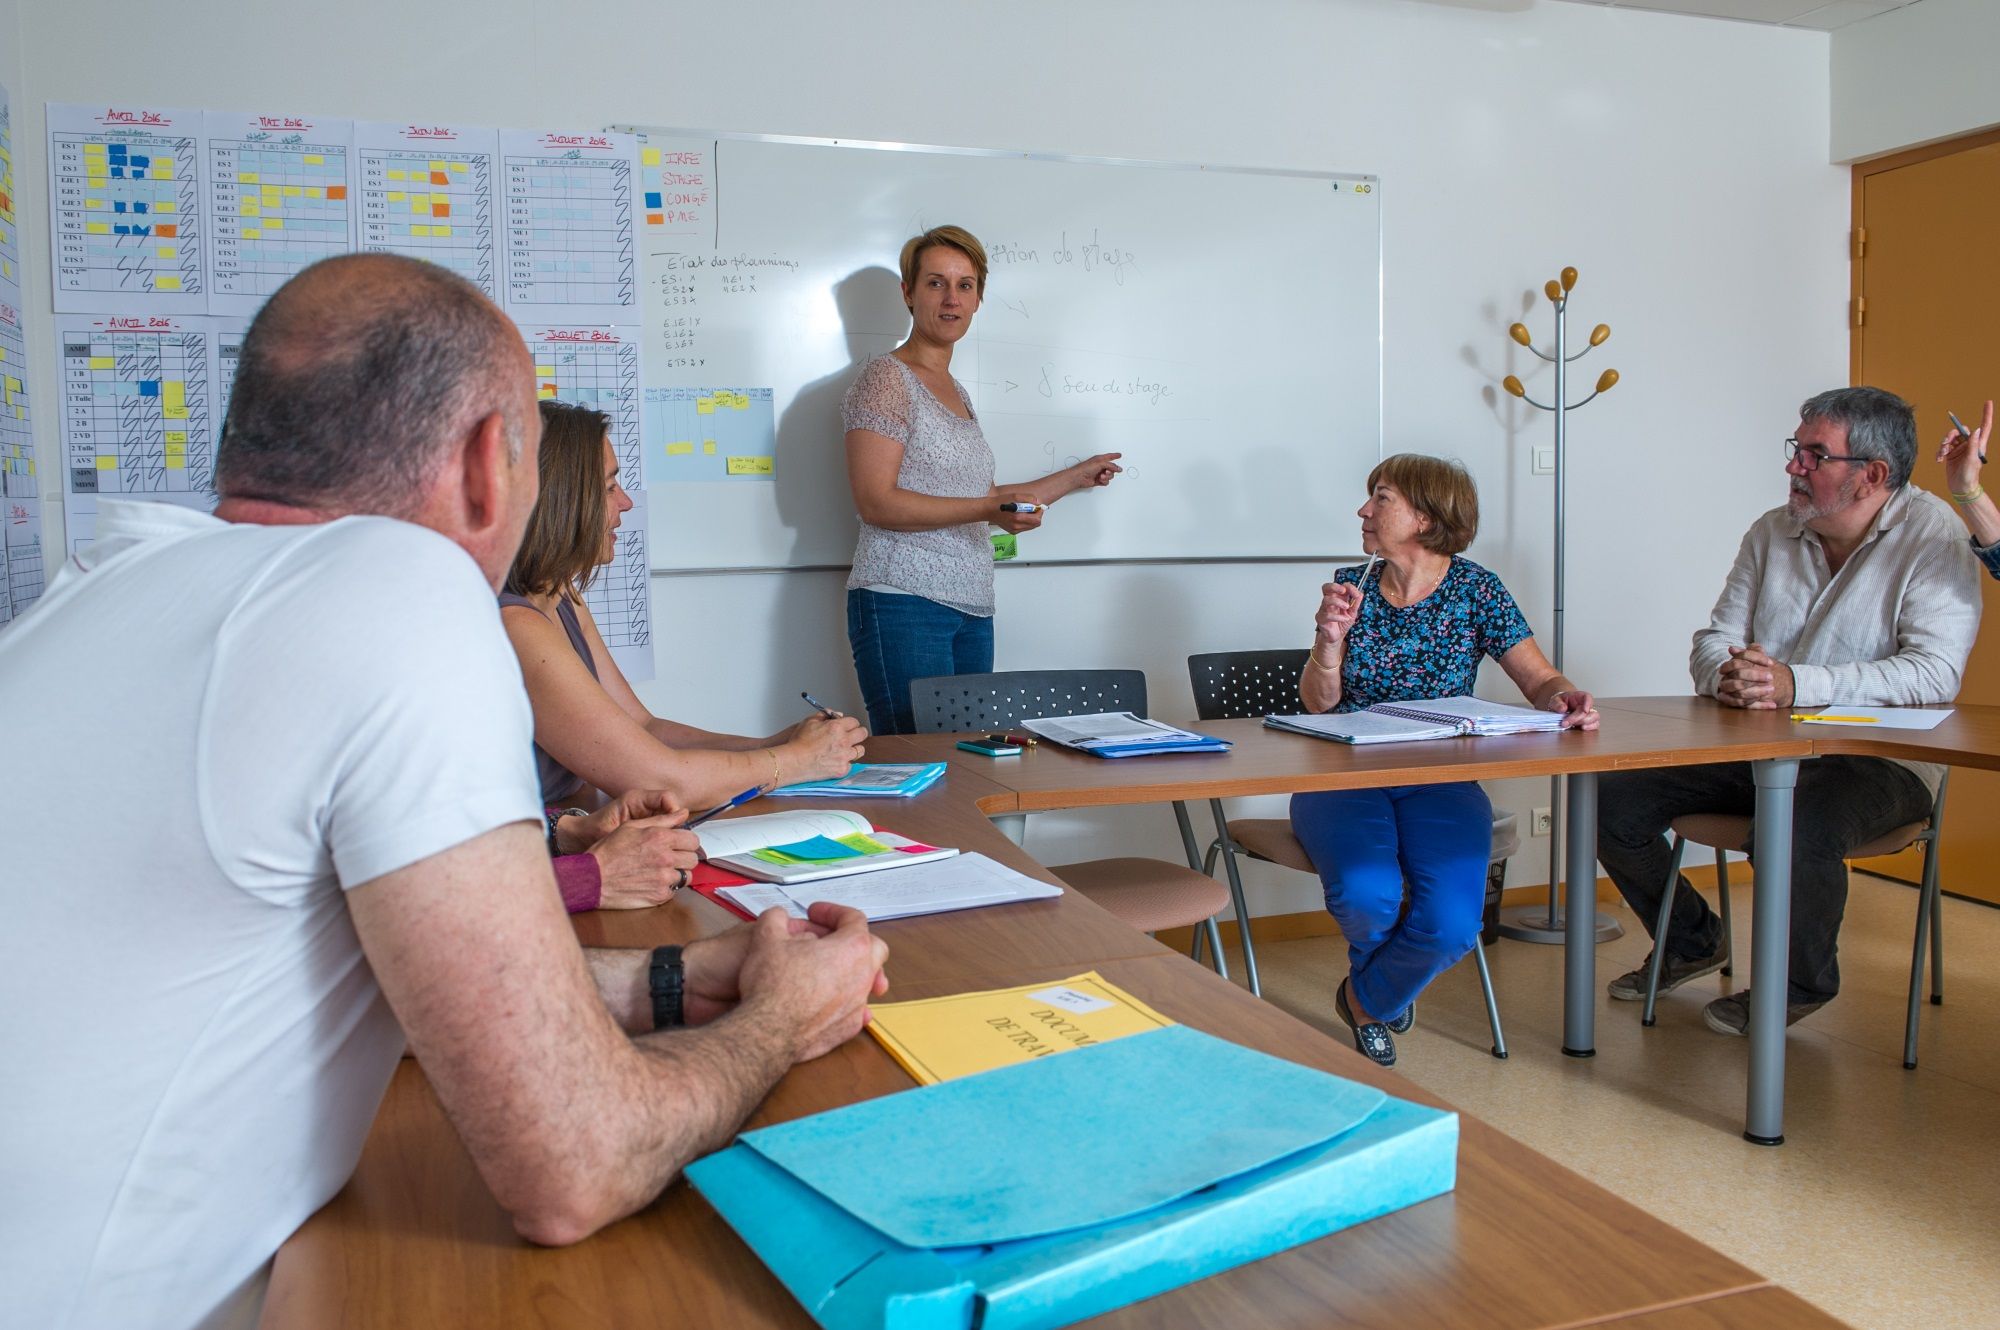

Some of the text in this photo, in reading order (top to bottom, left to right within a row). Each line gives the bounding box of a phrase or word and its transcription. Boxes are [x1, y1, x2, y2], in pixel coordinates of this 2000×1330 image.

[107, 108, 161, 122] AVRIL 2016
[284, 118, 302, 127] 2016
[433, 127, 449, 135] 2016
[589, 136, 607, 145] 2016
[663, 172, 703, 185] STAGE
[109, 317, 170, 329] AVRIL 2016
[591, 330, 611, 340] 2016
[986, 1016, 1021, 1032] DE
